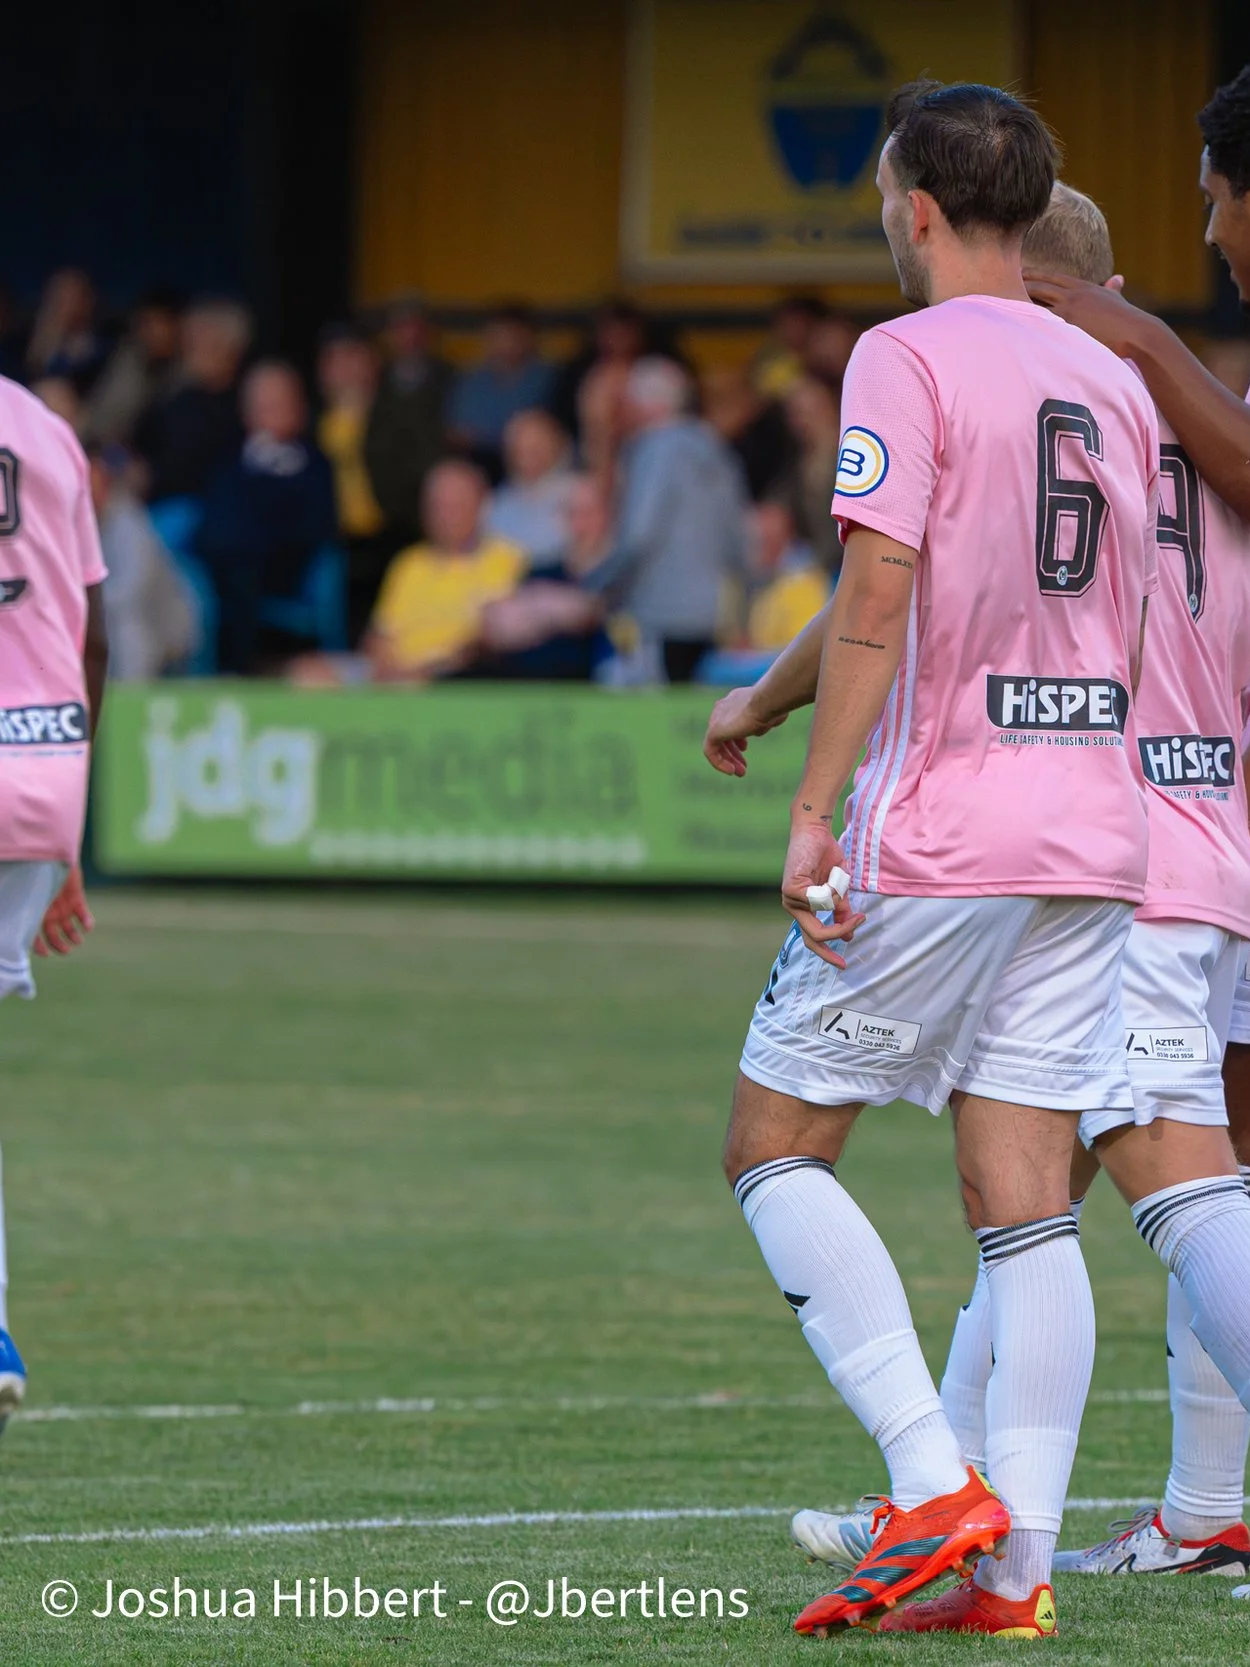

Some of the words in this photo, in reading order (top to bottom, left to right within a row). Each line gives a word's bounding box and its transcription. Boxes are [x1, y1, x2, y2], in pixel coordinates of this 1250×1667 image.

[1036, 398, 1110, 598] 6
[0, 704, 84, 743] iSPEC
[1000, 734, 1018, 744] LIFE
[1055, 736, 1090, 747] HOUSING
[862, 1025, 895, 1036] AZTEK
[1155, 1038, 1184, 1046] AZTEK
